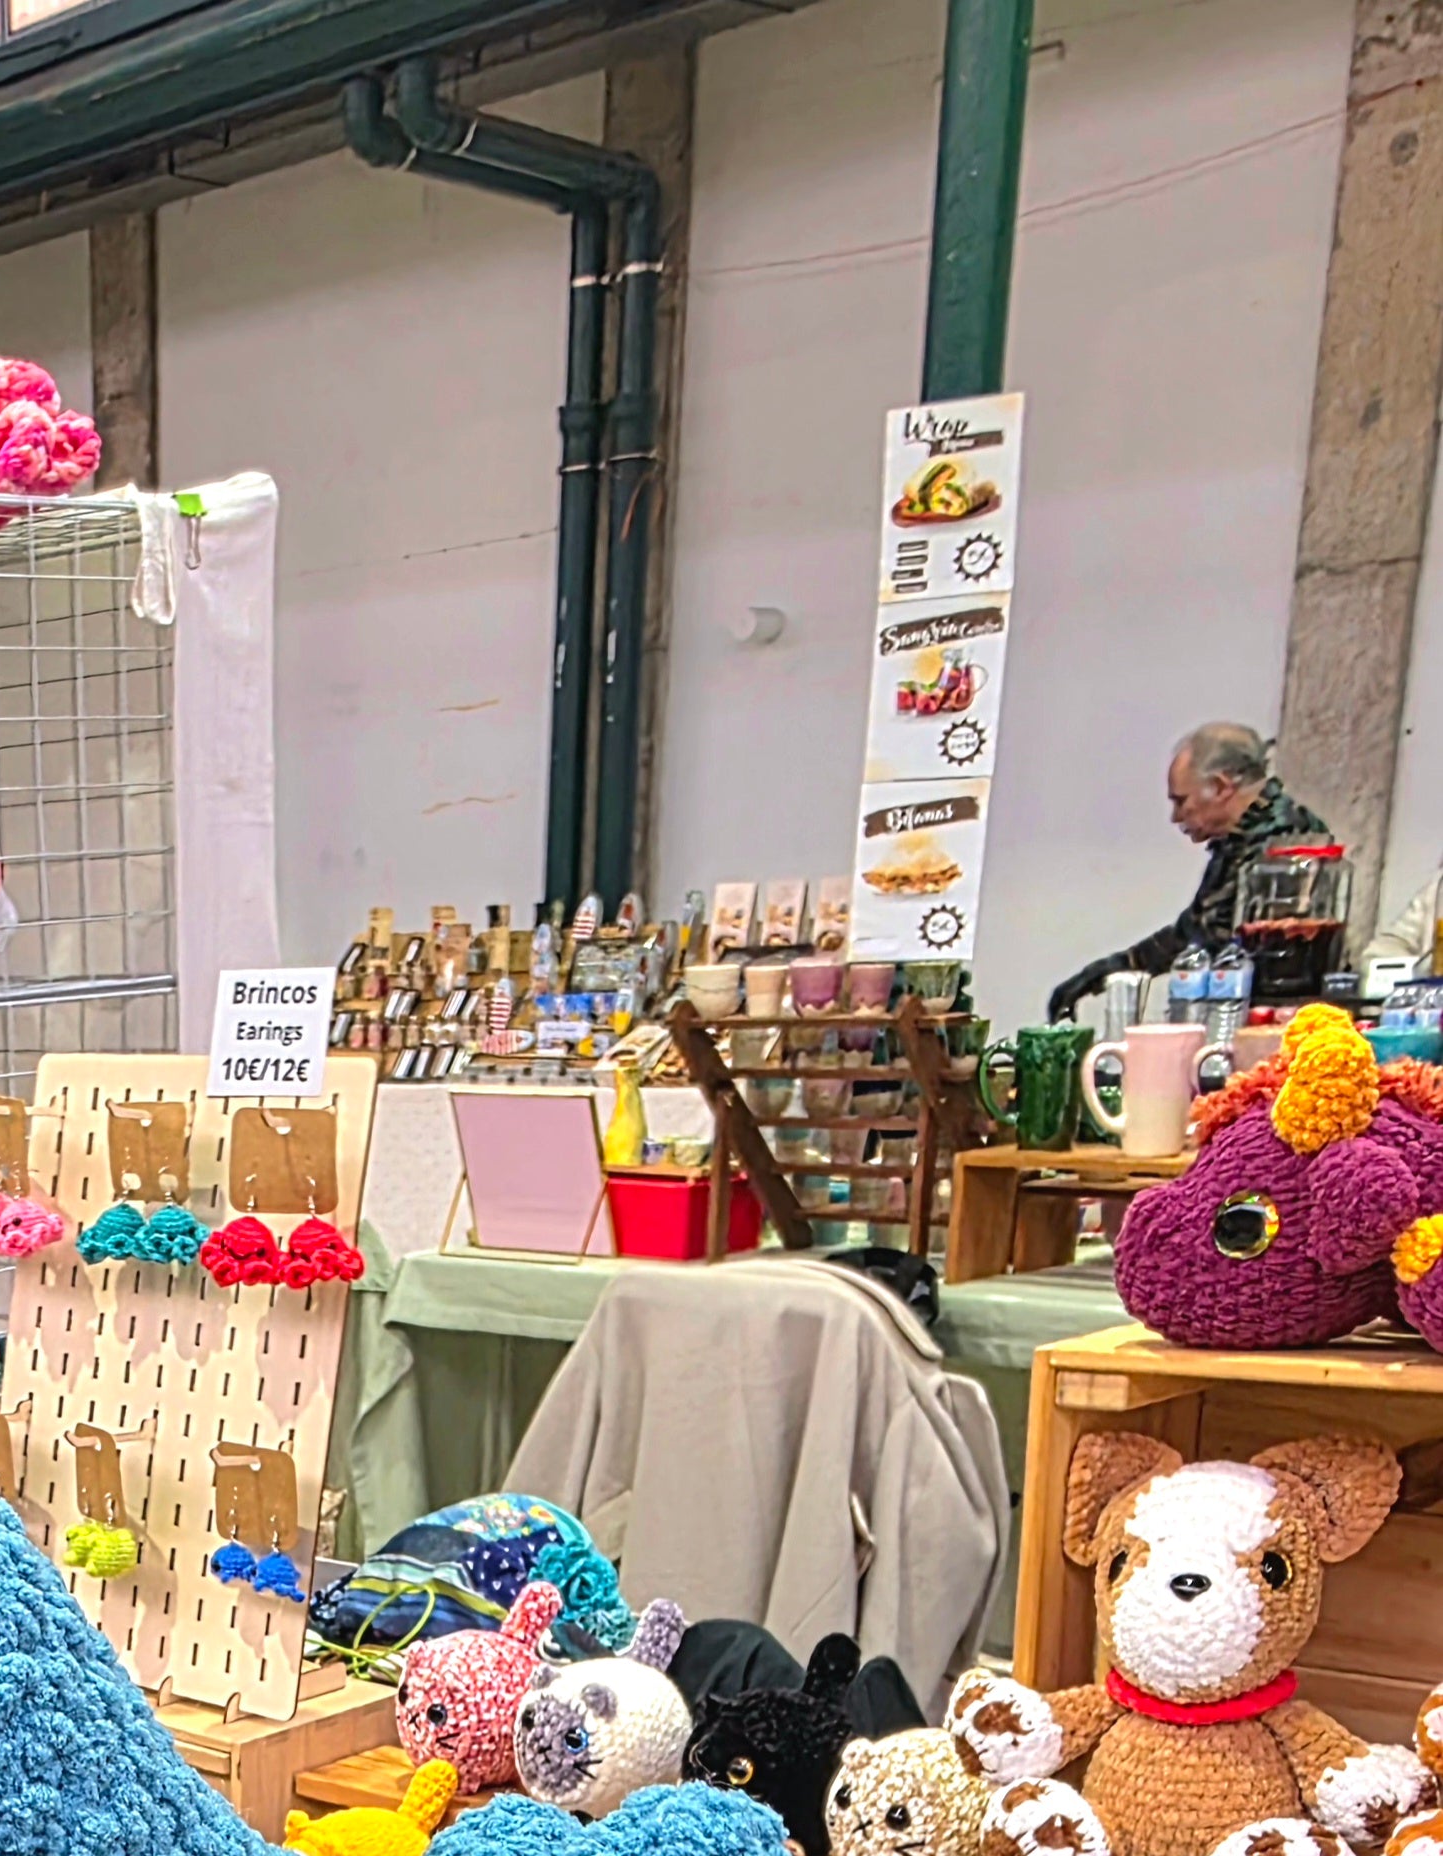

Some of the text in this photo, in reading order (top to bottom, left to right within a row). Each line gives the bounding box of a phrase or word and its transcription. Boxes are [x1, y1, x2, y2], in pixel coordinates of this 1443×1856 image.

[232, 980, 317, 1004] Brincos
[236, 1021, 303, 1046] Earings
[222, 1058, 310, 1082] 10€/12€
